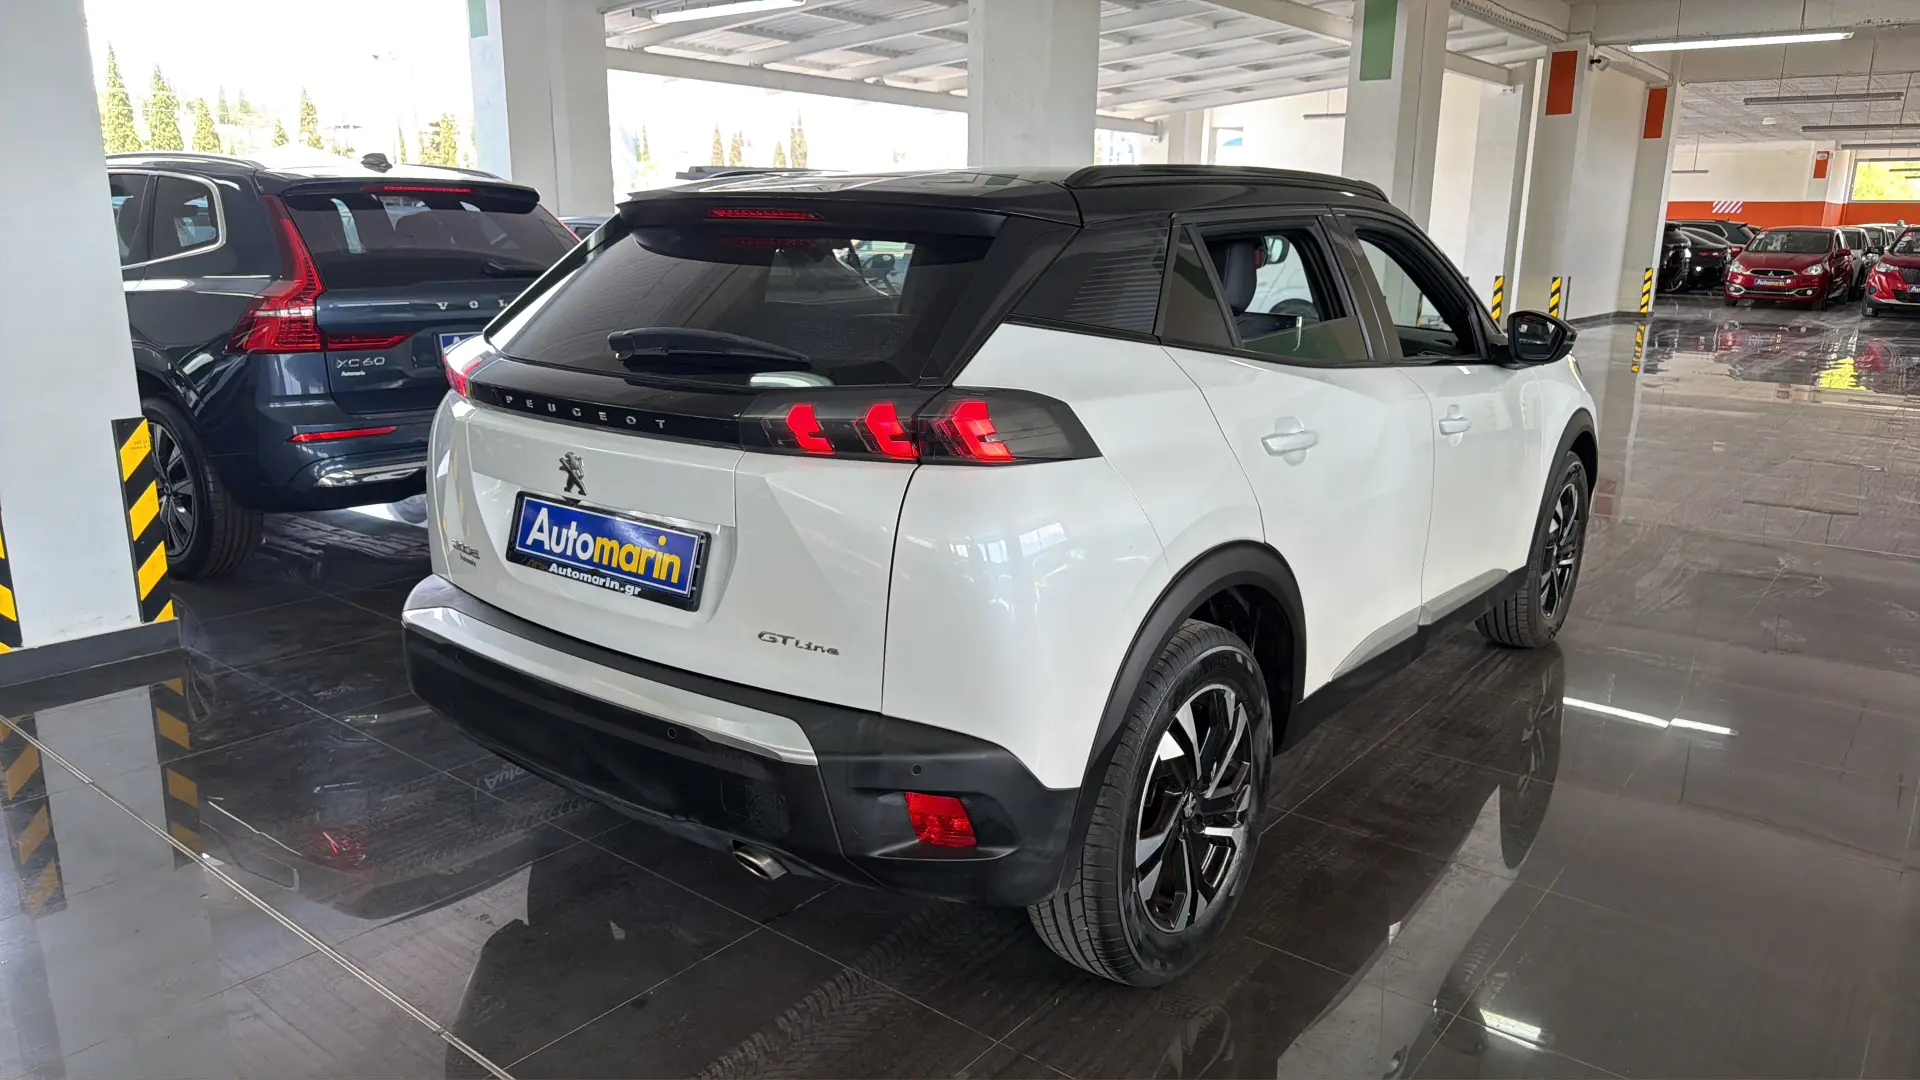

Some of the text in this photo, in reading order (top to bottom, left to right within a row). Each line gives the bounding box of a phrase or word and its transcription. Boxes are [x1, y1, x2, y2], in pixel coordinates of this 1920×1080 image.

[436, 299, 508, 310] VOL
[505, 395, 665, 429] PEUGEOT
[525, 507, 682, 584] Automarin
[549, 563, 642, 596] Automarin.gr
